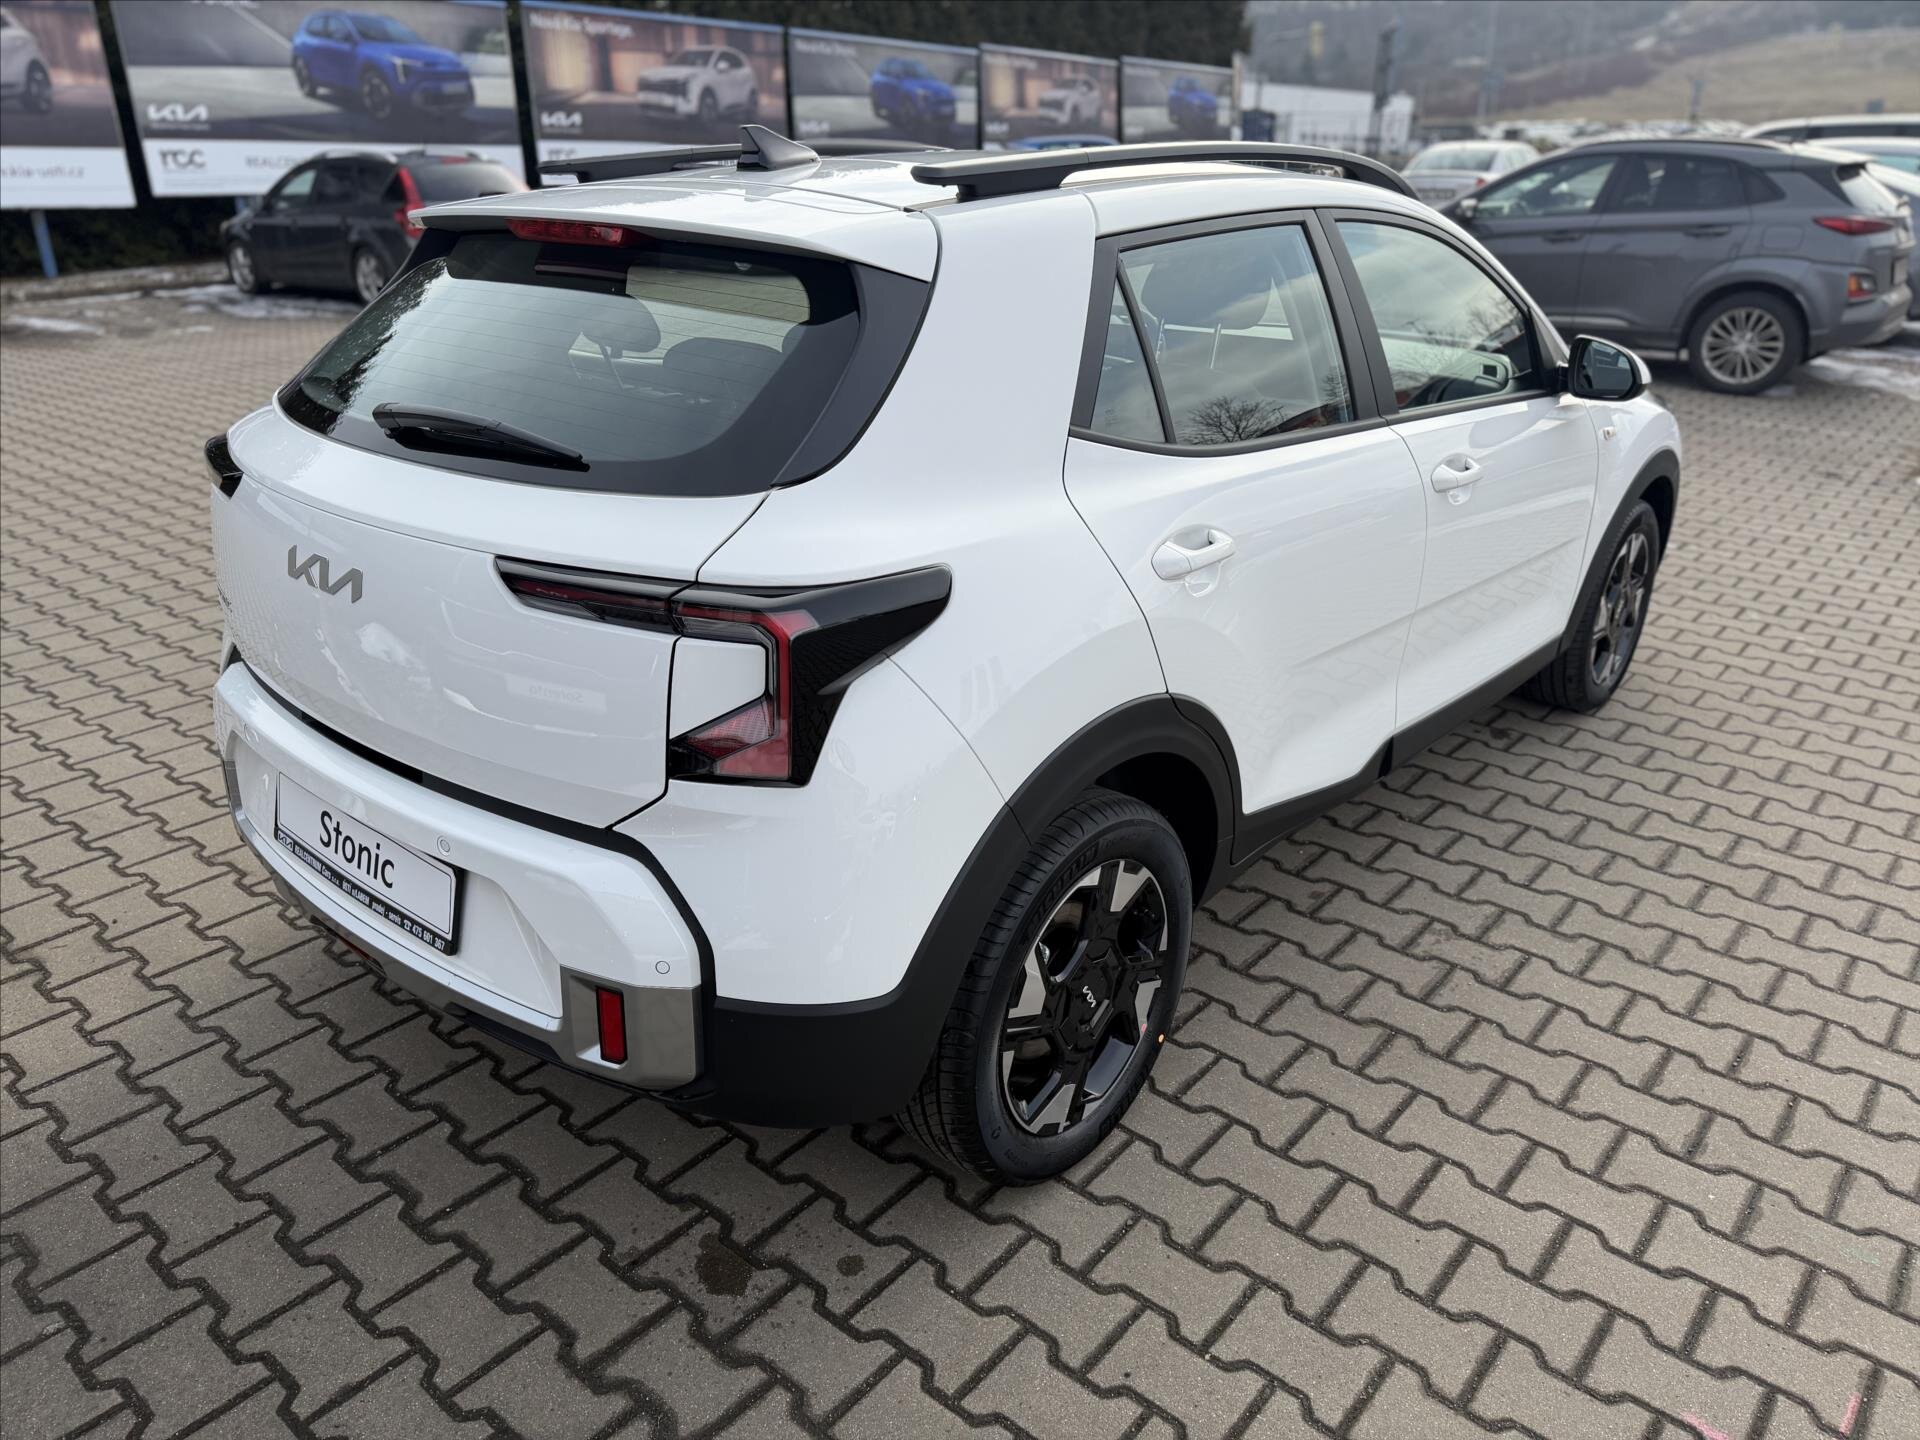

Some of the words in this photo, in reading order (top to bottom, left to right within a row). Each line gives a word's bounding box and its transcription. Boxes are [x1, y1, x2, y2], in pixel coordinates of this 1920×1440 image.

[147, 103, 210, 121] KIA
[541, 111, 582, 128] KIA
[288, 544, 363, 604] KIA
[278, 832, 294, 849] KIA
[319, 810, 395, 889] Stonic
[412, 925, 423, 939] 475
[423, 929, 433, 945] 601
[434, 936, 446, 952] 367
